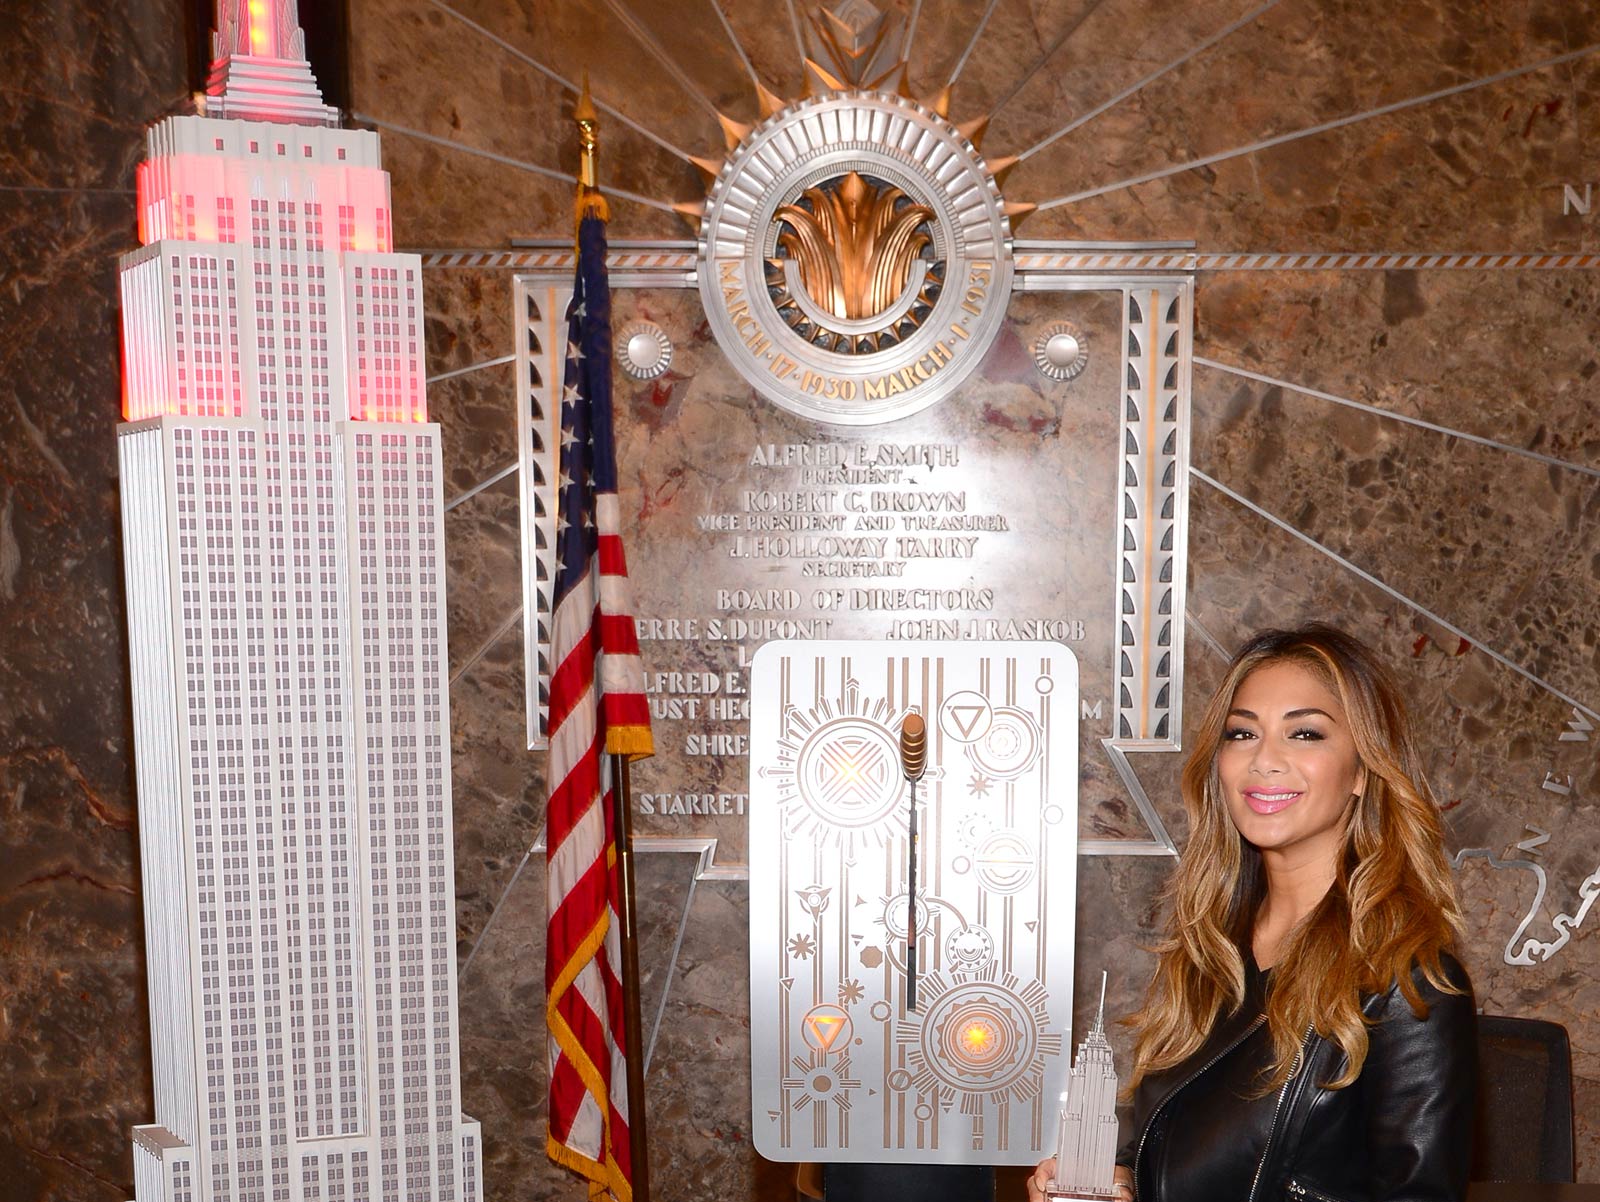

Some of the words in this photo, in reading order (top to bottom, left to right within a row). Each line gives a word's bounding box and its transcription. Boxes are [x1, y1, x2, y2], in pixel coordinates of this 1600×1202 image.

[1564, 183, 1592, 216] N
[719, 260, 773, 358] MARCH
[768, 353, 798, 379] 17
[800, 370, 857, 401] 1930
[863, 341, 954, 401] MARCH
[960, 261, 994, 317] 1931
[750, 443, 847, 467] ALFRED
[802, 468, 903, 485] PRESIDENT
[743, 490, 838, 512] ROBERT
[871, 490, 967, 512] BROWN
[697, 515, 739, 531] VICE
[746, 515, 847, 532] PRESIDENT
[854, 516, 895, 531] AND
[903, 515, 1010, 532] TREASURER
[896, 536, 979, 559] TARRY
[801, 561, 907, 578] SECRETARY
[716, 589, 801, 611] BOARD
[811, 589, 844, 611] OF
[850, 588, 994, 611] DIRECTORS
[635, 619, 699, 640] ERRE
[886, 619, 959, 641] JOHN
[643, 672, 720, 694] LFRED
[648, 698, 700, 720] UST
[686, 734, 750, 756] SHRE
[640, 793, 750, 815] STARRET
